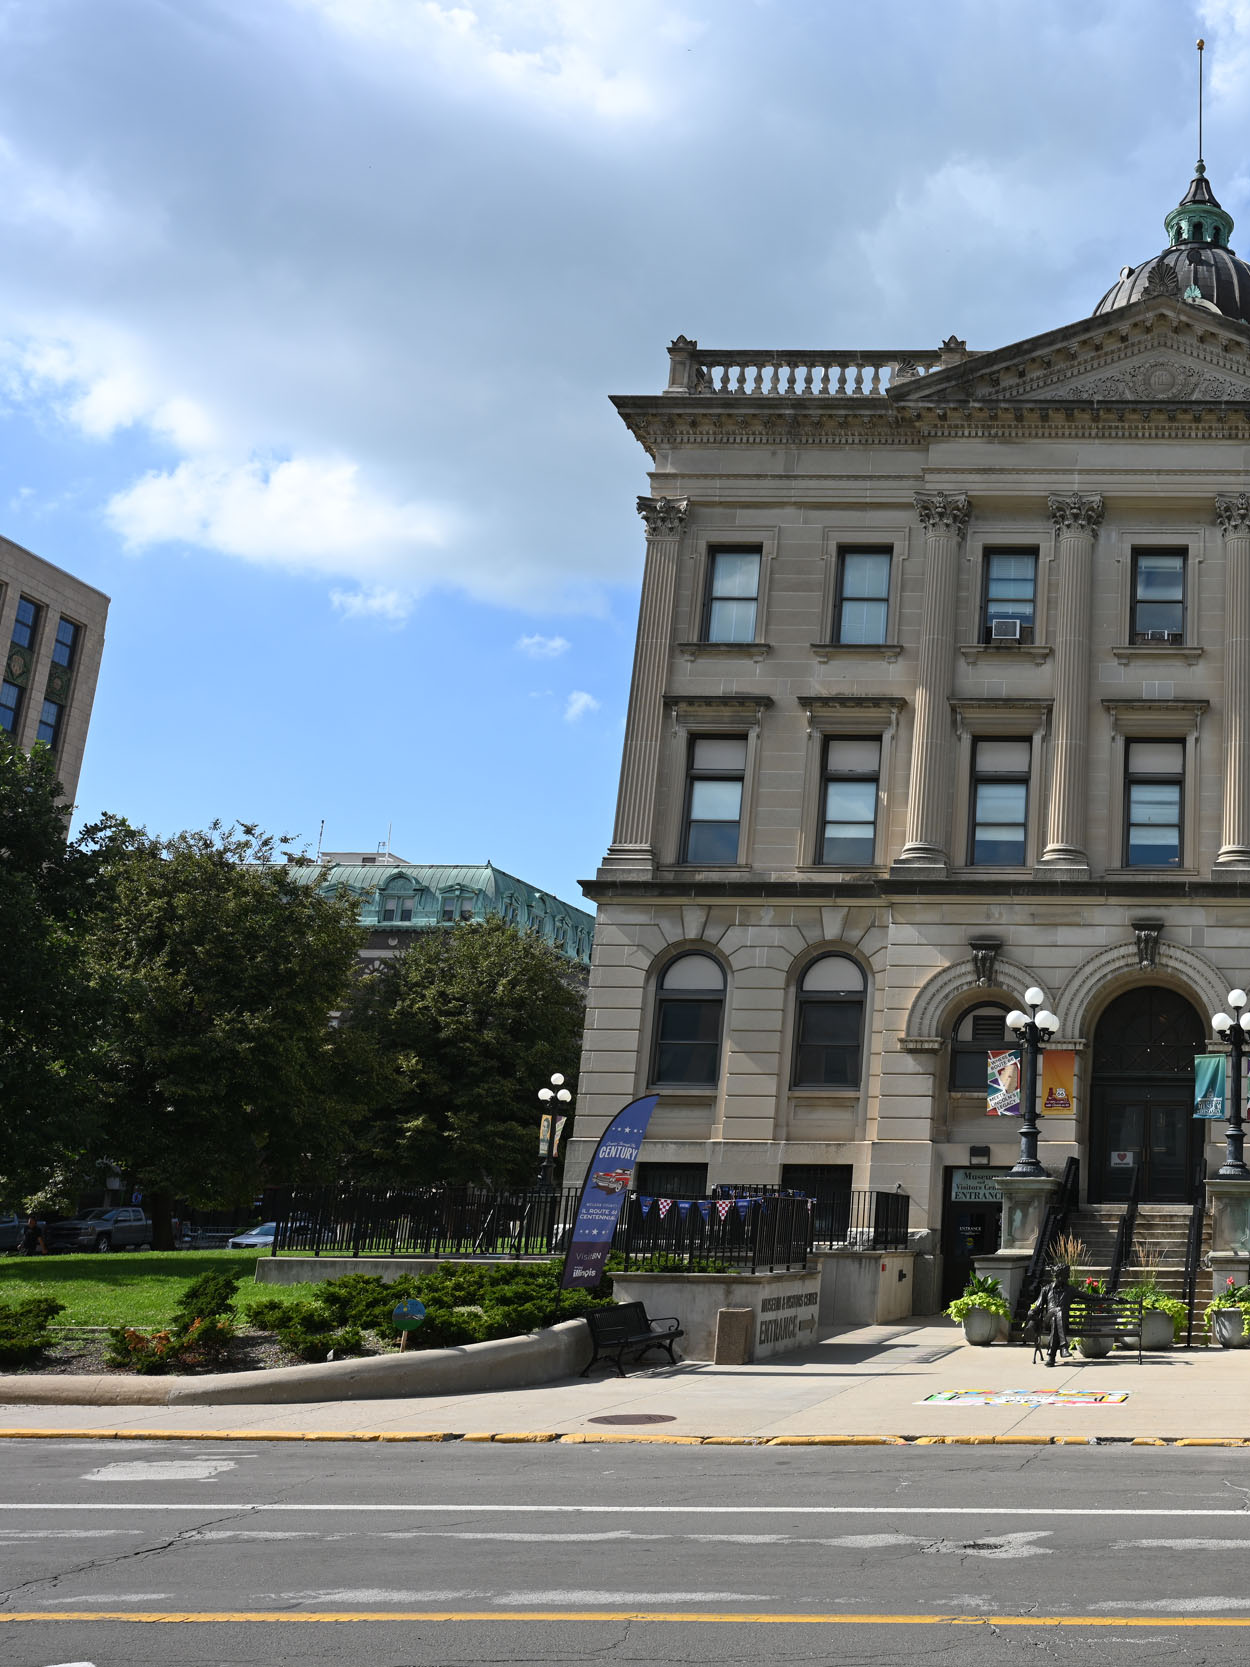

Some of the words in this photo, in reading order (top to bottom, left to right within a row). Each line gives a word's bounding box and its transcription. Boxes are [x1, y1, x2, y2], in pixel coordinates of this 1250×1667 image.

[990, 1054, 1009, 1065] WHERE
[991, 1060, 1007, 1071] ROUTE
[599, 1146, 638, 1161] CENTURY
[956, 1183, 982, 1191] Visitors
[761, 1296, 782, 1313] MUSEUM
[759, 1315, 798, 1345] ENTRANCE
